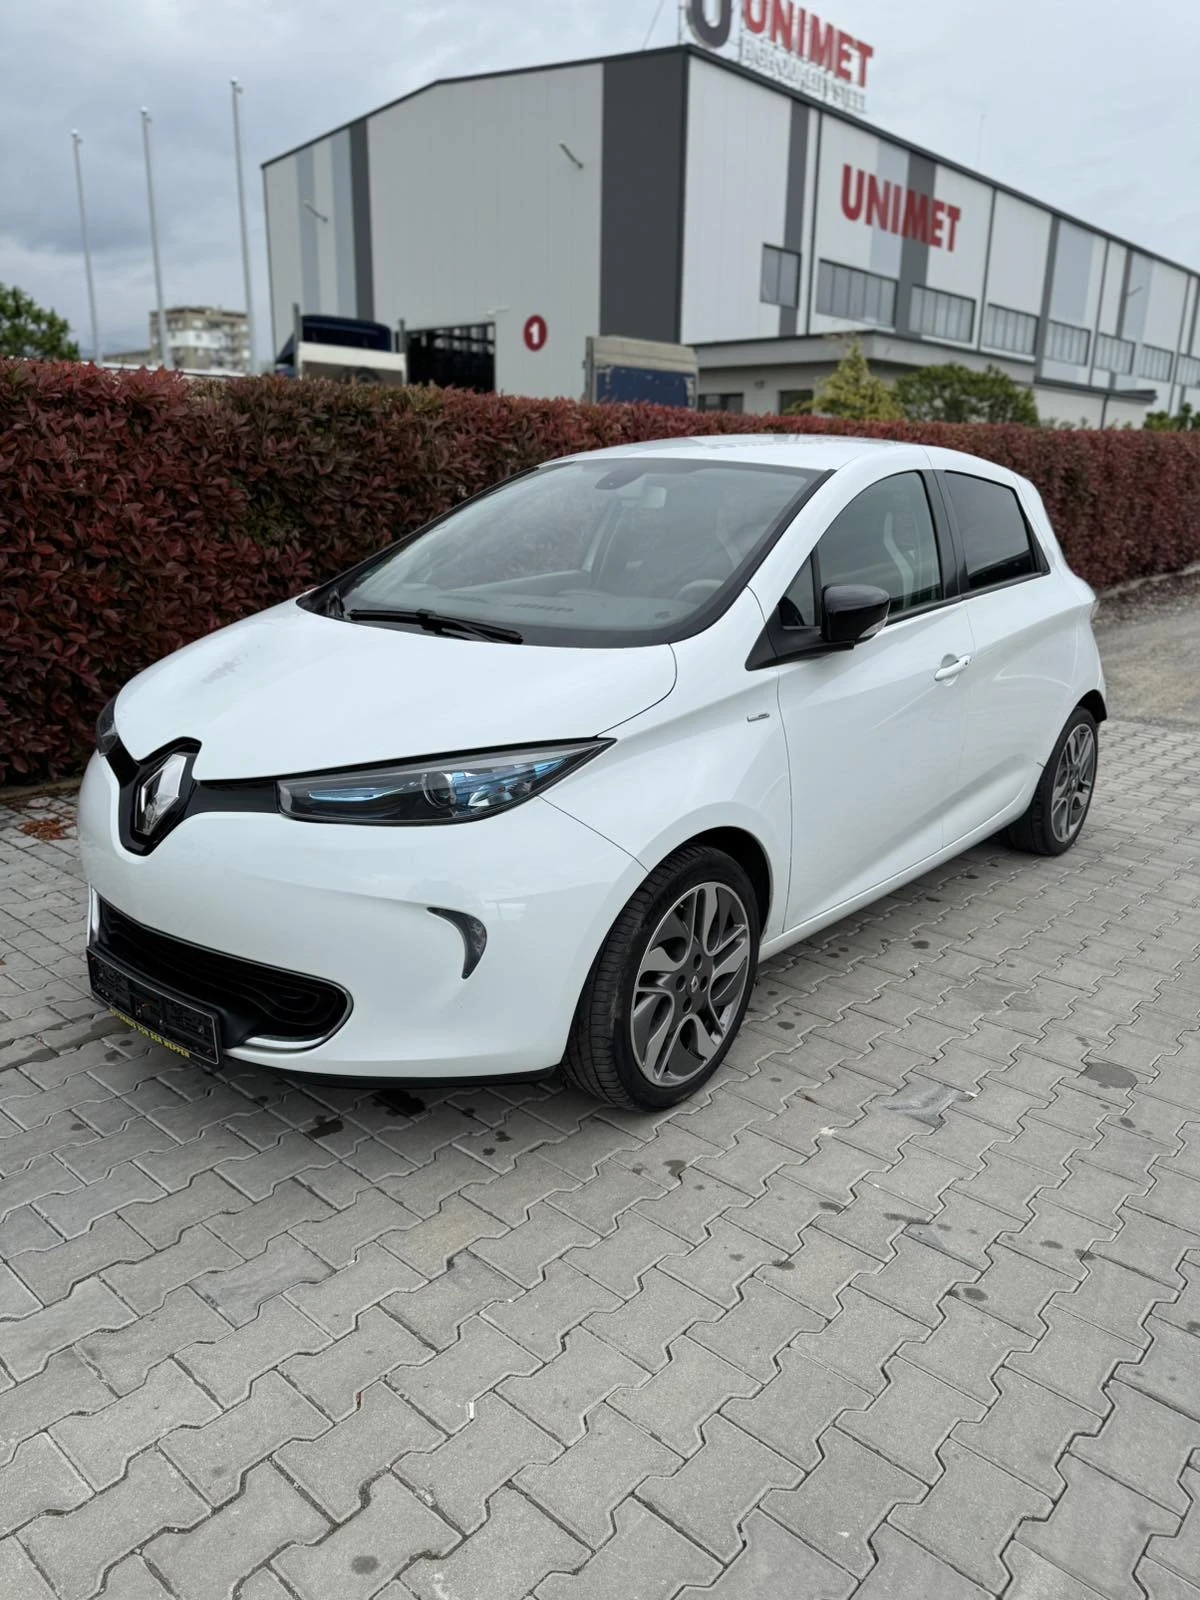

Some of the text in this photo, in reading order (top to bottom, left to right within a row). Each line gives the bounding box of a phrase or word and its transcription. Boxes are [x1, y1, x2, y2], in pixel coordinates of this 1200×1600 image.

[744, 0, 874, 87] UNIMET
[841, 164, 961, 252] UNIMET
[529, 321, 541, 346] 1
